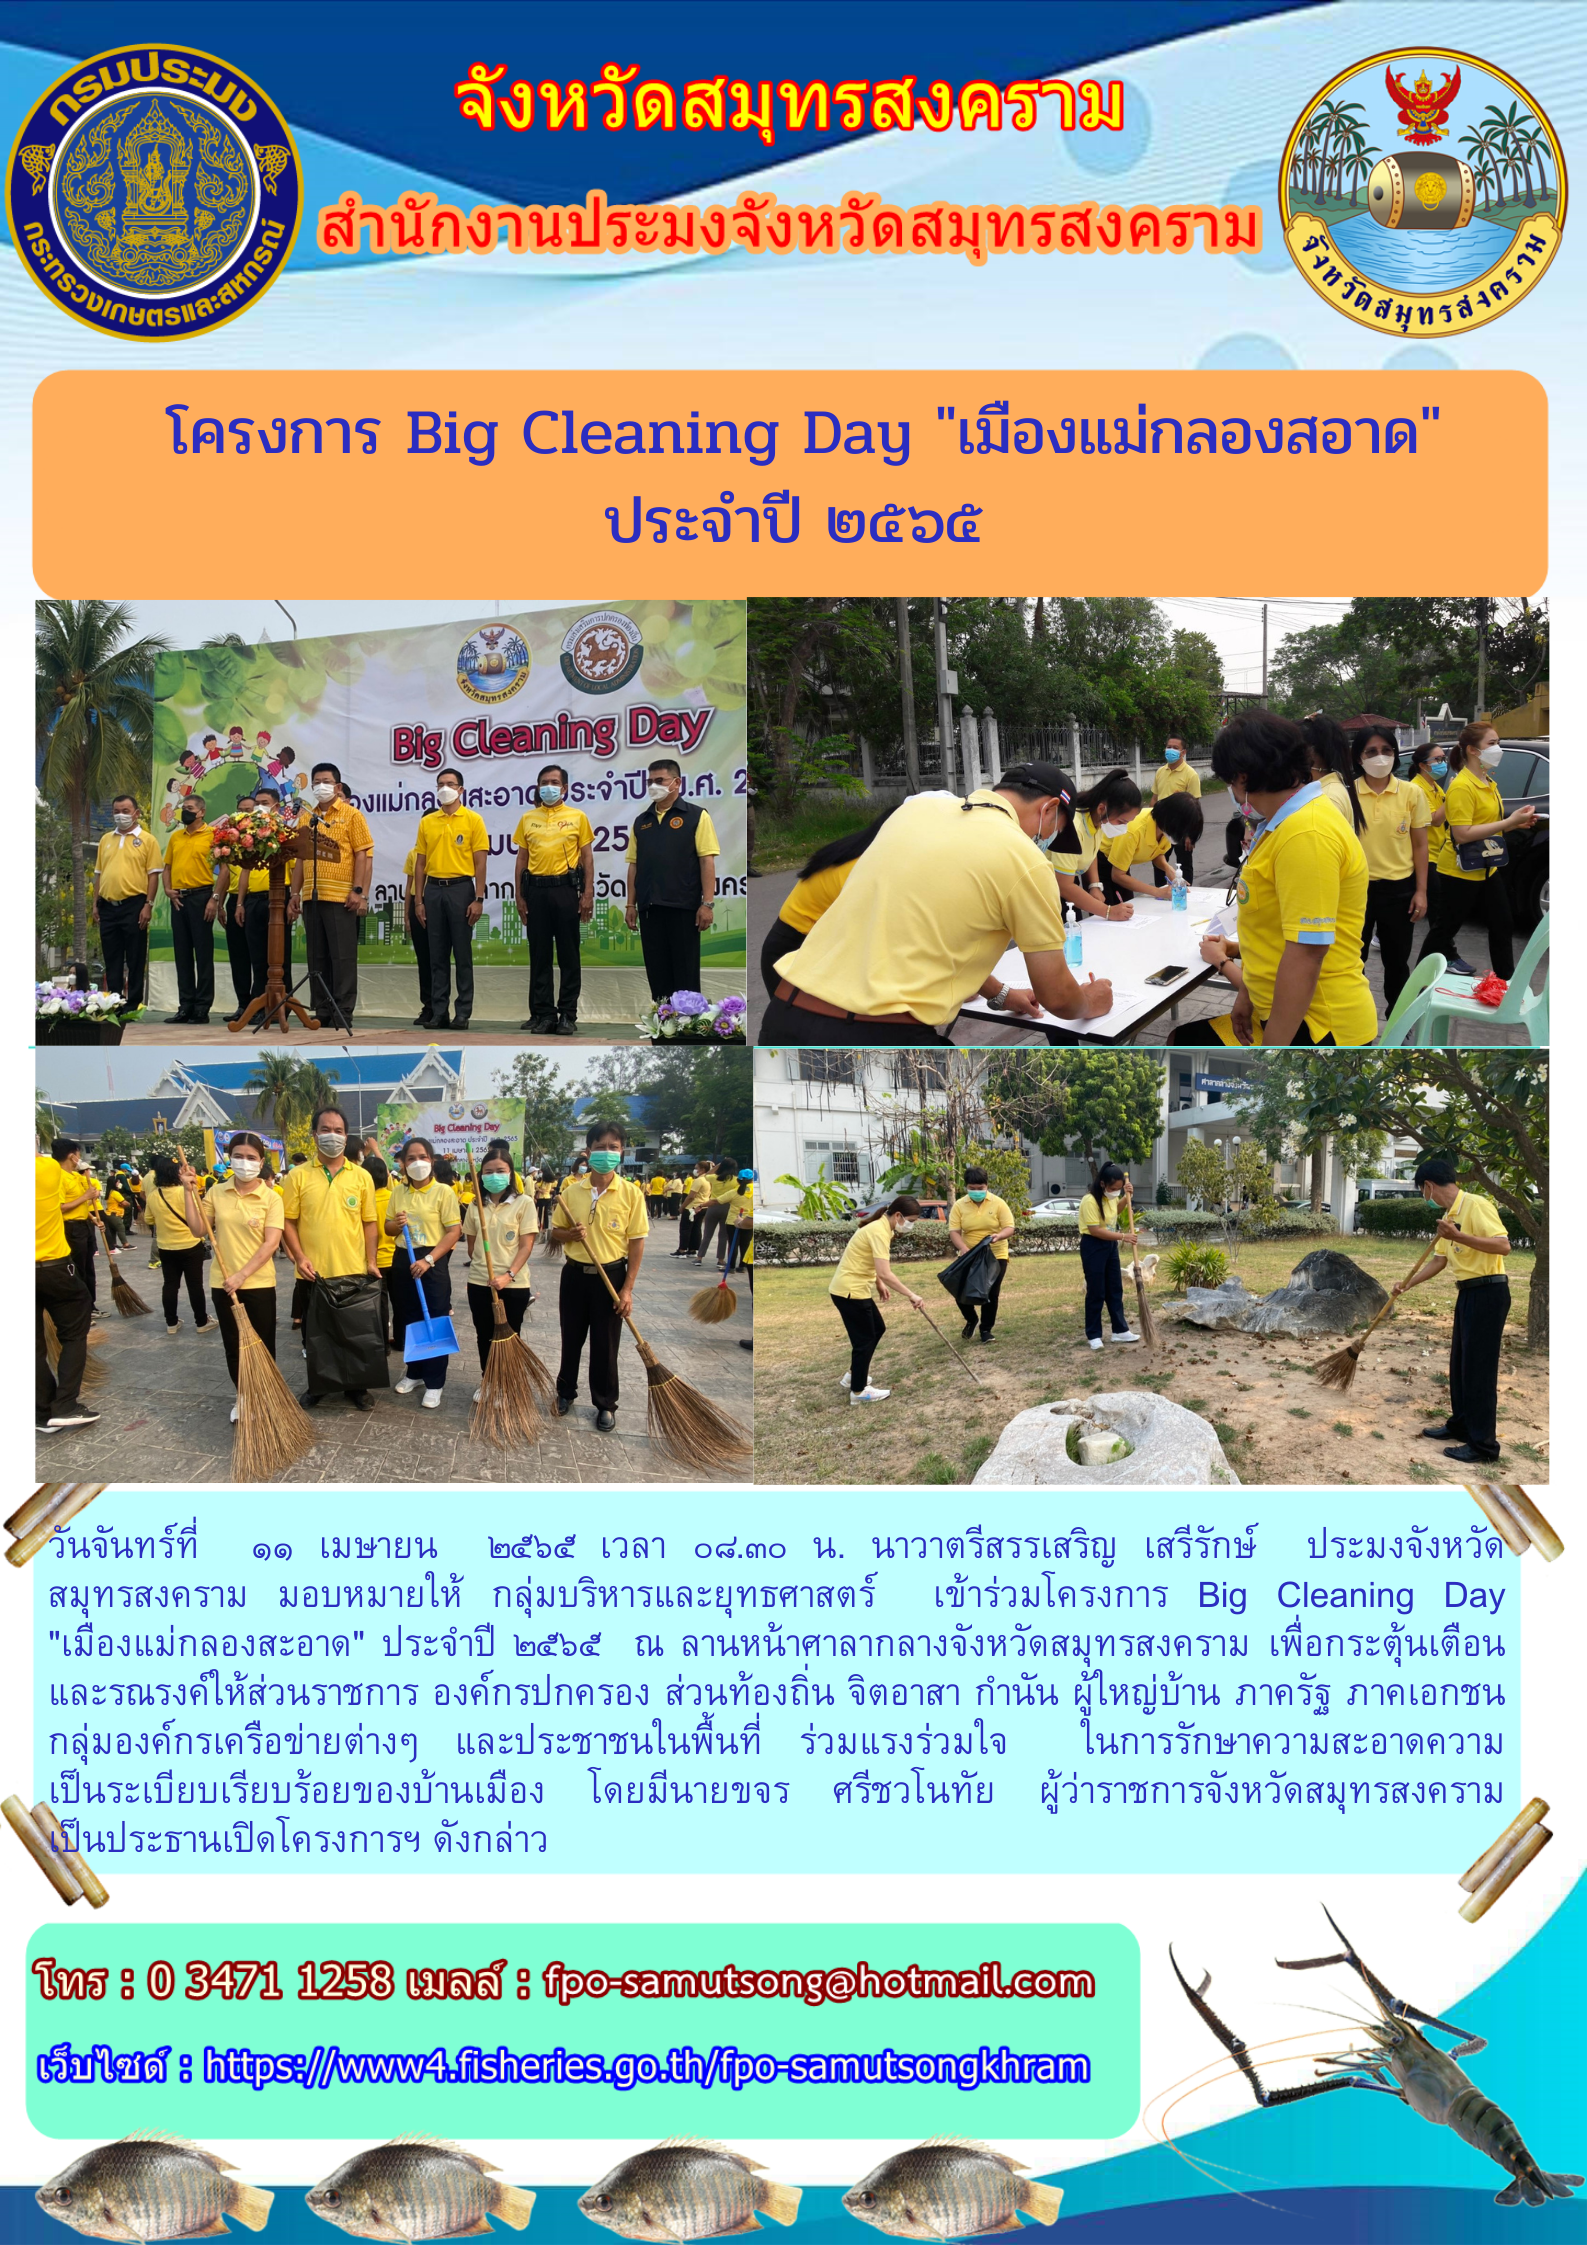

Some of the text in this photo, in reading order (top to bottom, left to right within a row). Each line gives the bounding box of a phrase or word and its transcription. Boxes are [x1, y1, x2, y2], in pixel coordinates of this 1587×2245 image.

[392, 704, 714, 770] Big Cleaning Day
[434, 1122, 501, 1134] Big Cleaning Day
